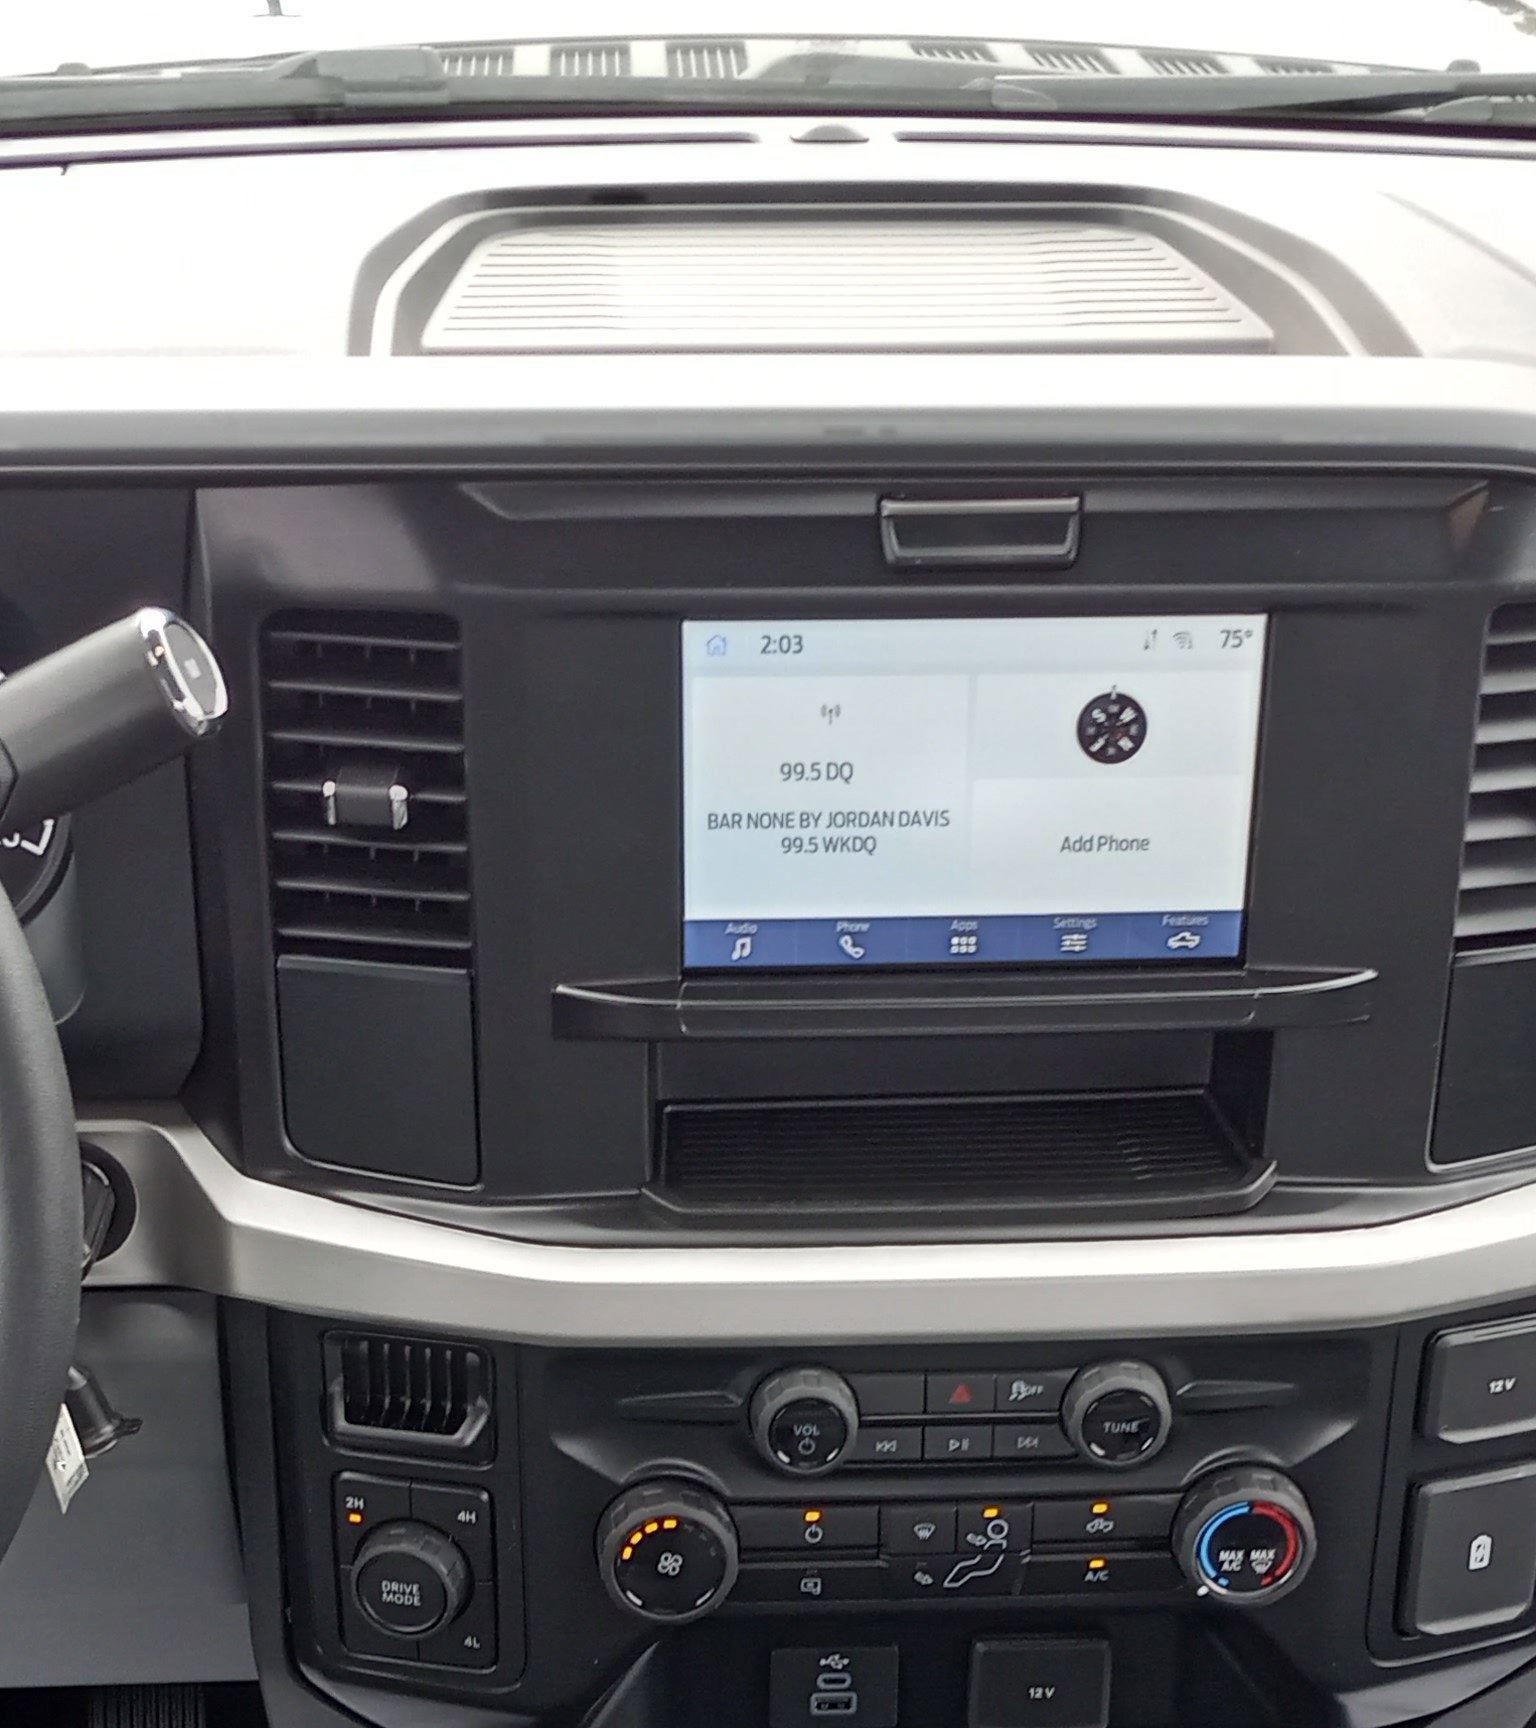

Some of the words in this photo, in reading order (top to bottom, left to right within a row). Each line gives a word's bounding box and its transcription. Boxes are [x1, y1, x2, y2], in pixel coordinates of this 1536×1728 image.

[760, 634, 804, 655] 2:03
[780, 762, 821, 782] 99.5
[826, 761, 854, 784] DQ
[707, 812, 742, 830] BAR
[746, 812, 795, 830] NONE
[799, 811, 823, 829] BY
[826, 810, 894, 829] JORDAN
[898, 809, 950, 827] DAVIS
[781, 837, 819, 854] 99.5
[822, 835, 877, 856] WKDQ
[1060, 835, 1093, 853] Add
[1097, 835, 1150, 852] Phone
[836, 921, 871, 932] Phone
[951, 920, 978, 932] Apps
[1053, 916, 1097, 930] Settings
[1161, 914, 1208, 927] Features
[725, 922, 758, 935] Audio
[793, 1424, 820, 1436] VOL
[1104, 1421, 1139, 1433] TUNE
[345, 1496, 364, 1510] 2H
[457, 1511, 477, 1524] 4H
[1219, 1550, 1245, 1562] MAX
[1249, 1548, 1277, 1561] MAX
[1221, 1561, 1241, 1572] A/C
[1084, 1570, 1109, 1582] A/C
[382, 1580, 420, 1595] DRIVE
[382, 1593, 421, 1607] MODE
[464, 1635, 481, 1649] 4L
